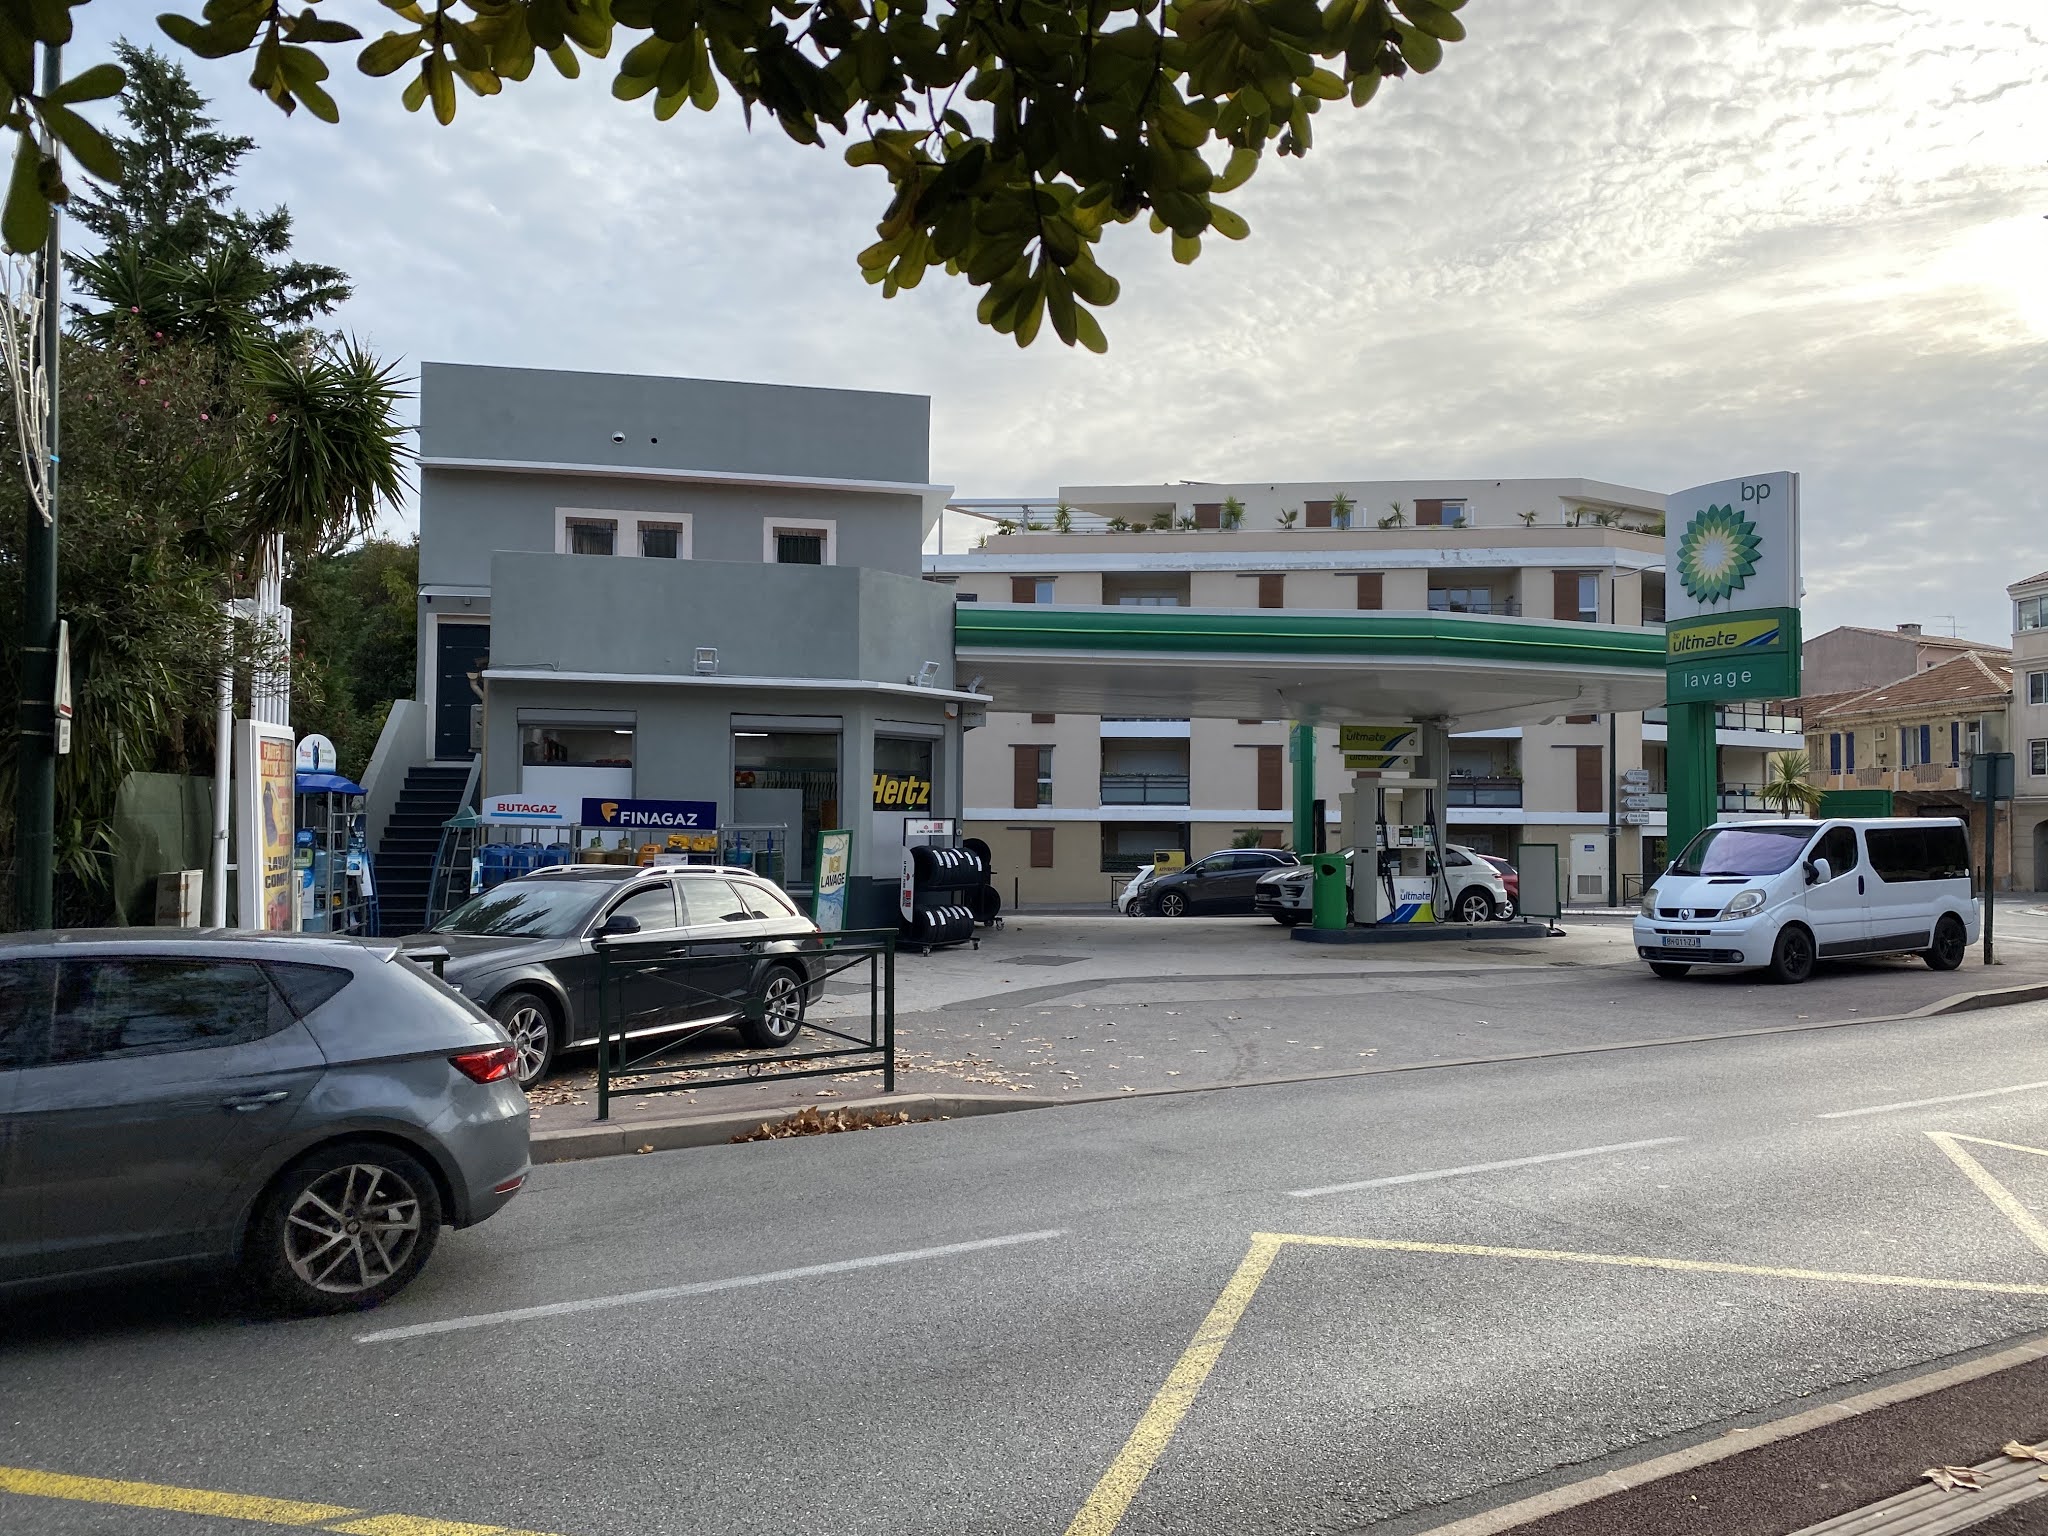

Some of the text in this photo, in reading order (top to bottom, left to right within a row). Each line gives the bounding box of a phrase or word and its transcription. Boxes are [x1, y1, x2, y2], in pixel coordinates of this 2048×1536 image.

[1740, 481, 1771, 504] bp
[1673, 631, 1738, 652] ultimate
[1684, 671, 1753, 688] lavage
[872, 774, 931, 805] Hertz
[497, 803, 557, 814] BUTAGAZ
[620, 811, 698, 826] FINAGAZ
[821, 872, 845, 888] LAVAGE
